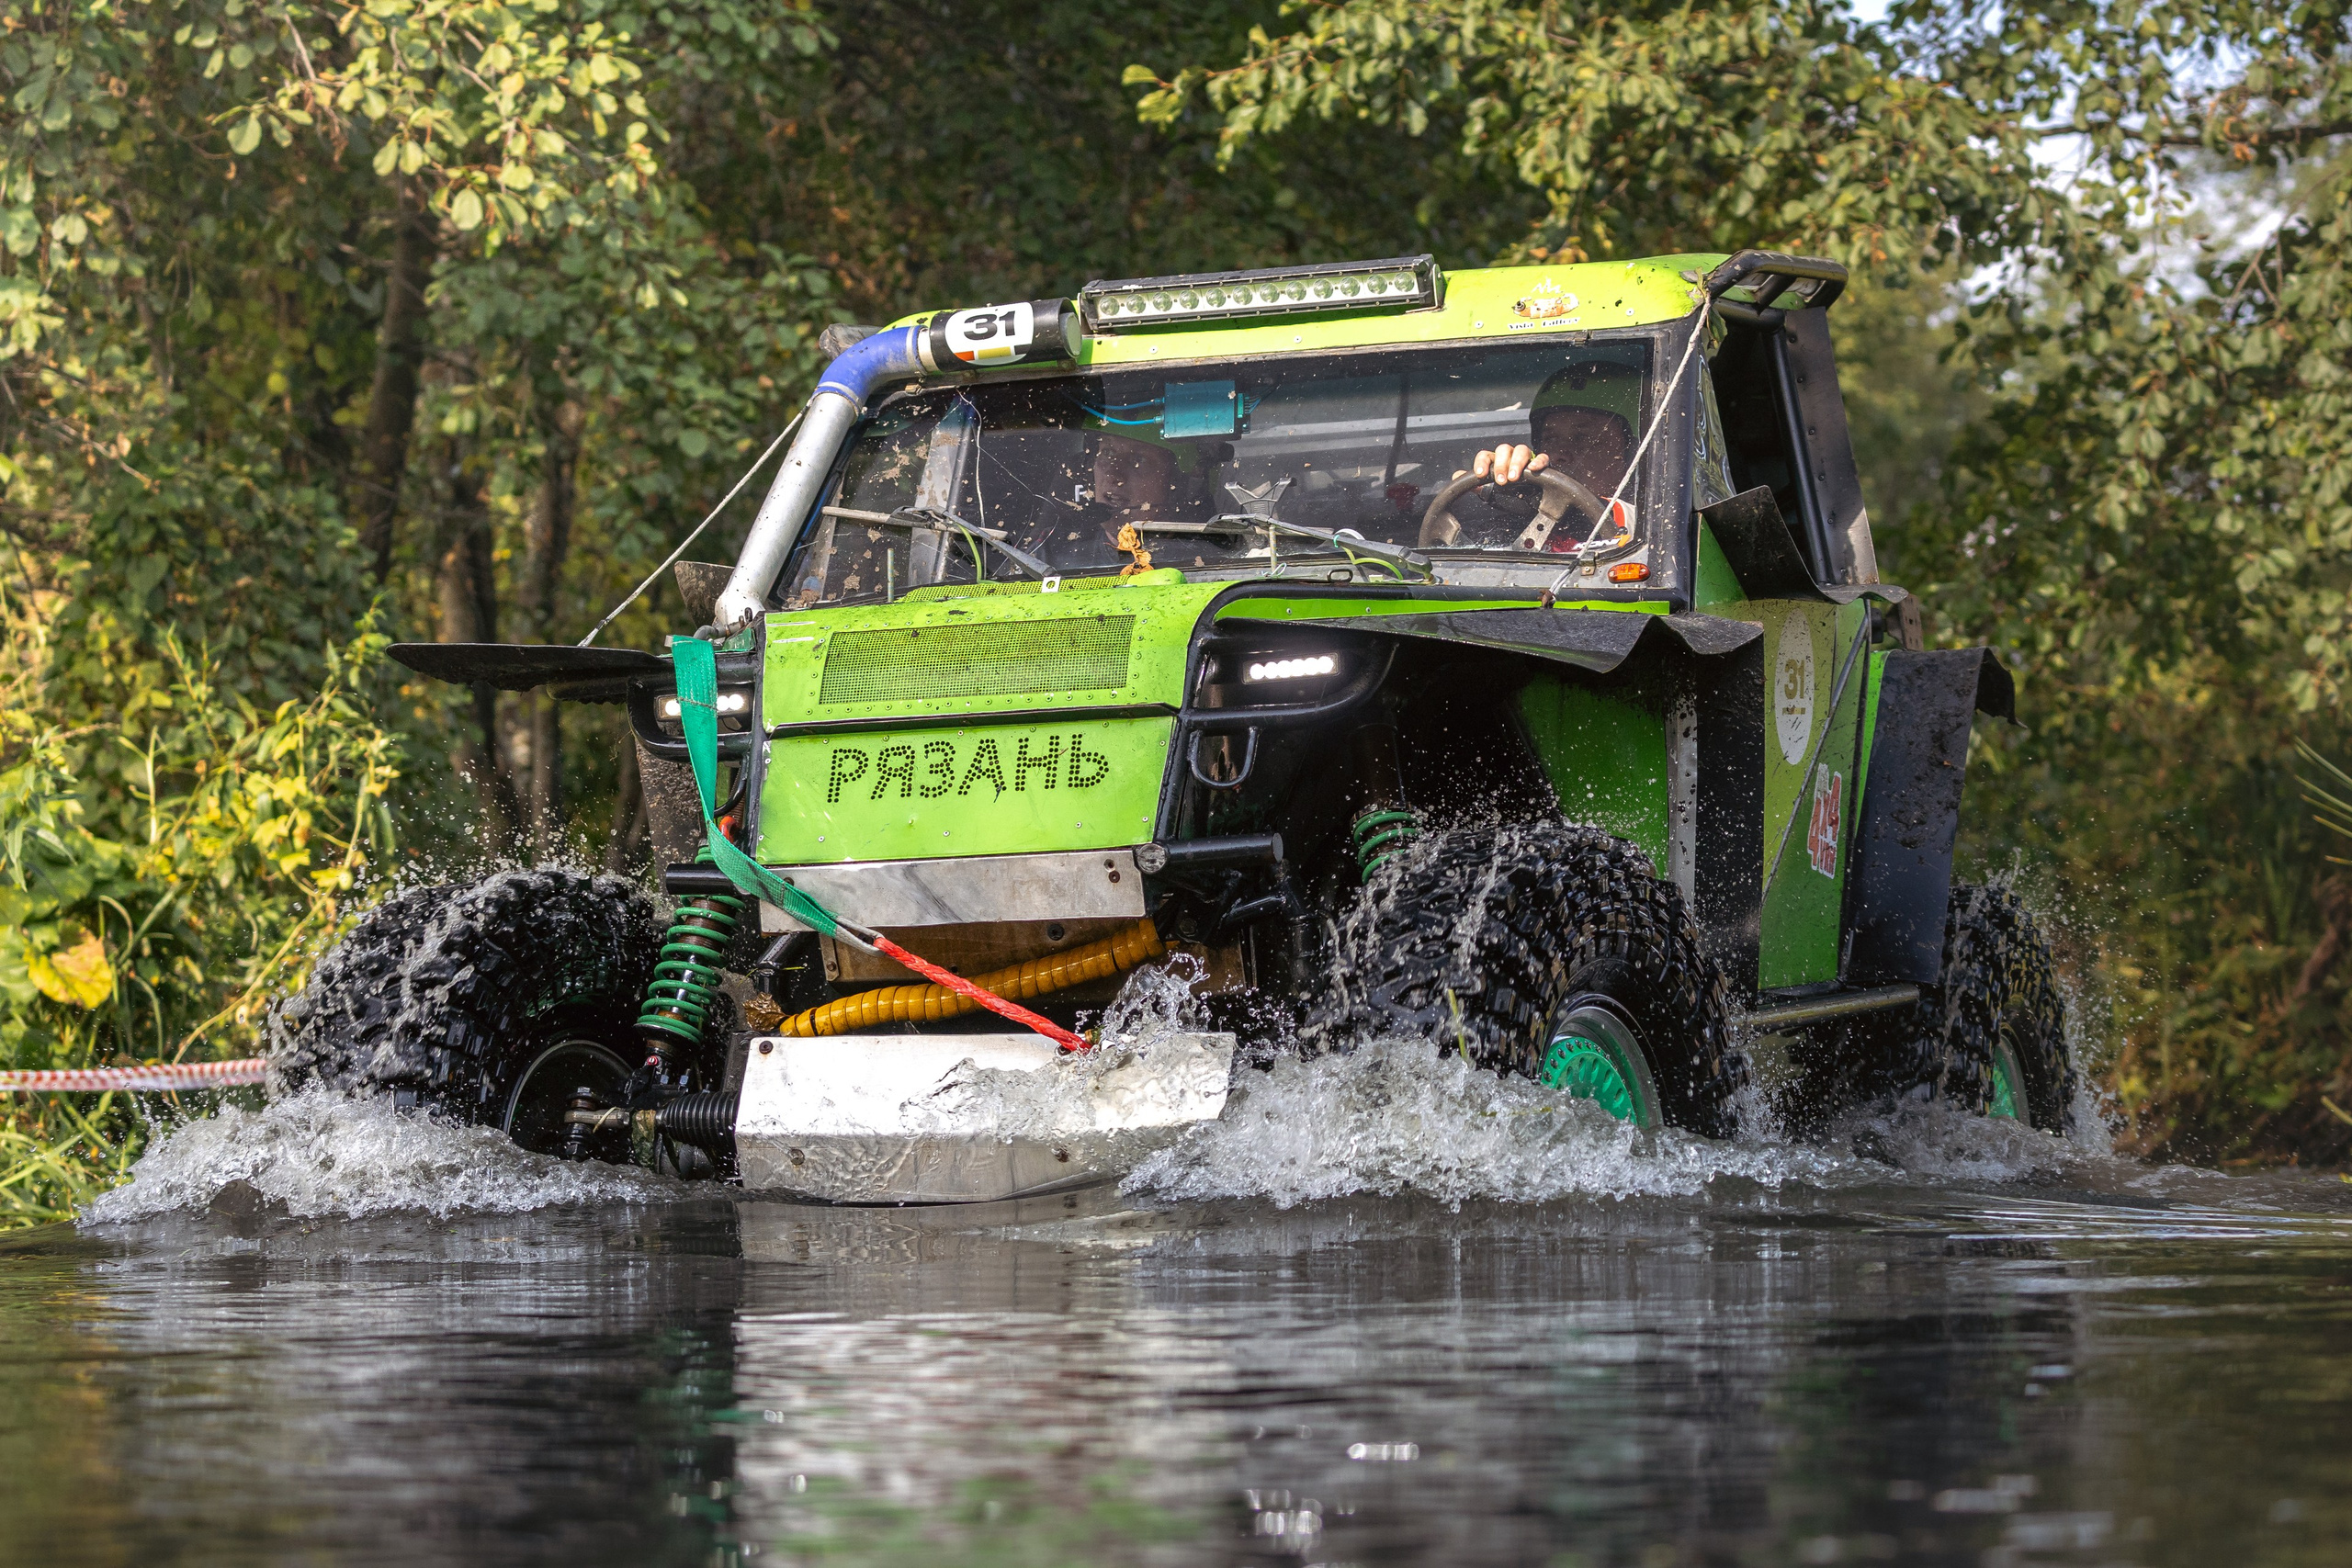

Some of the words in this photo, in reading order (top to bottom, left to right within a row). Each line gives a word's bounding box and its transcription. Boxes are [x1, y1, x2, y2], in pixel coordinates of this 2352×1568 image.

[964, 310, 1016, 341] 31
[1784, 659, 1804, 699] 31
[827, 733, 1110, 804] РЯЗАНЬ
